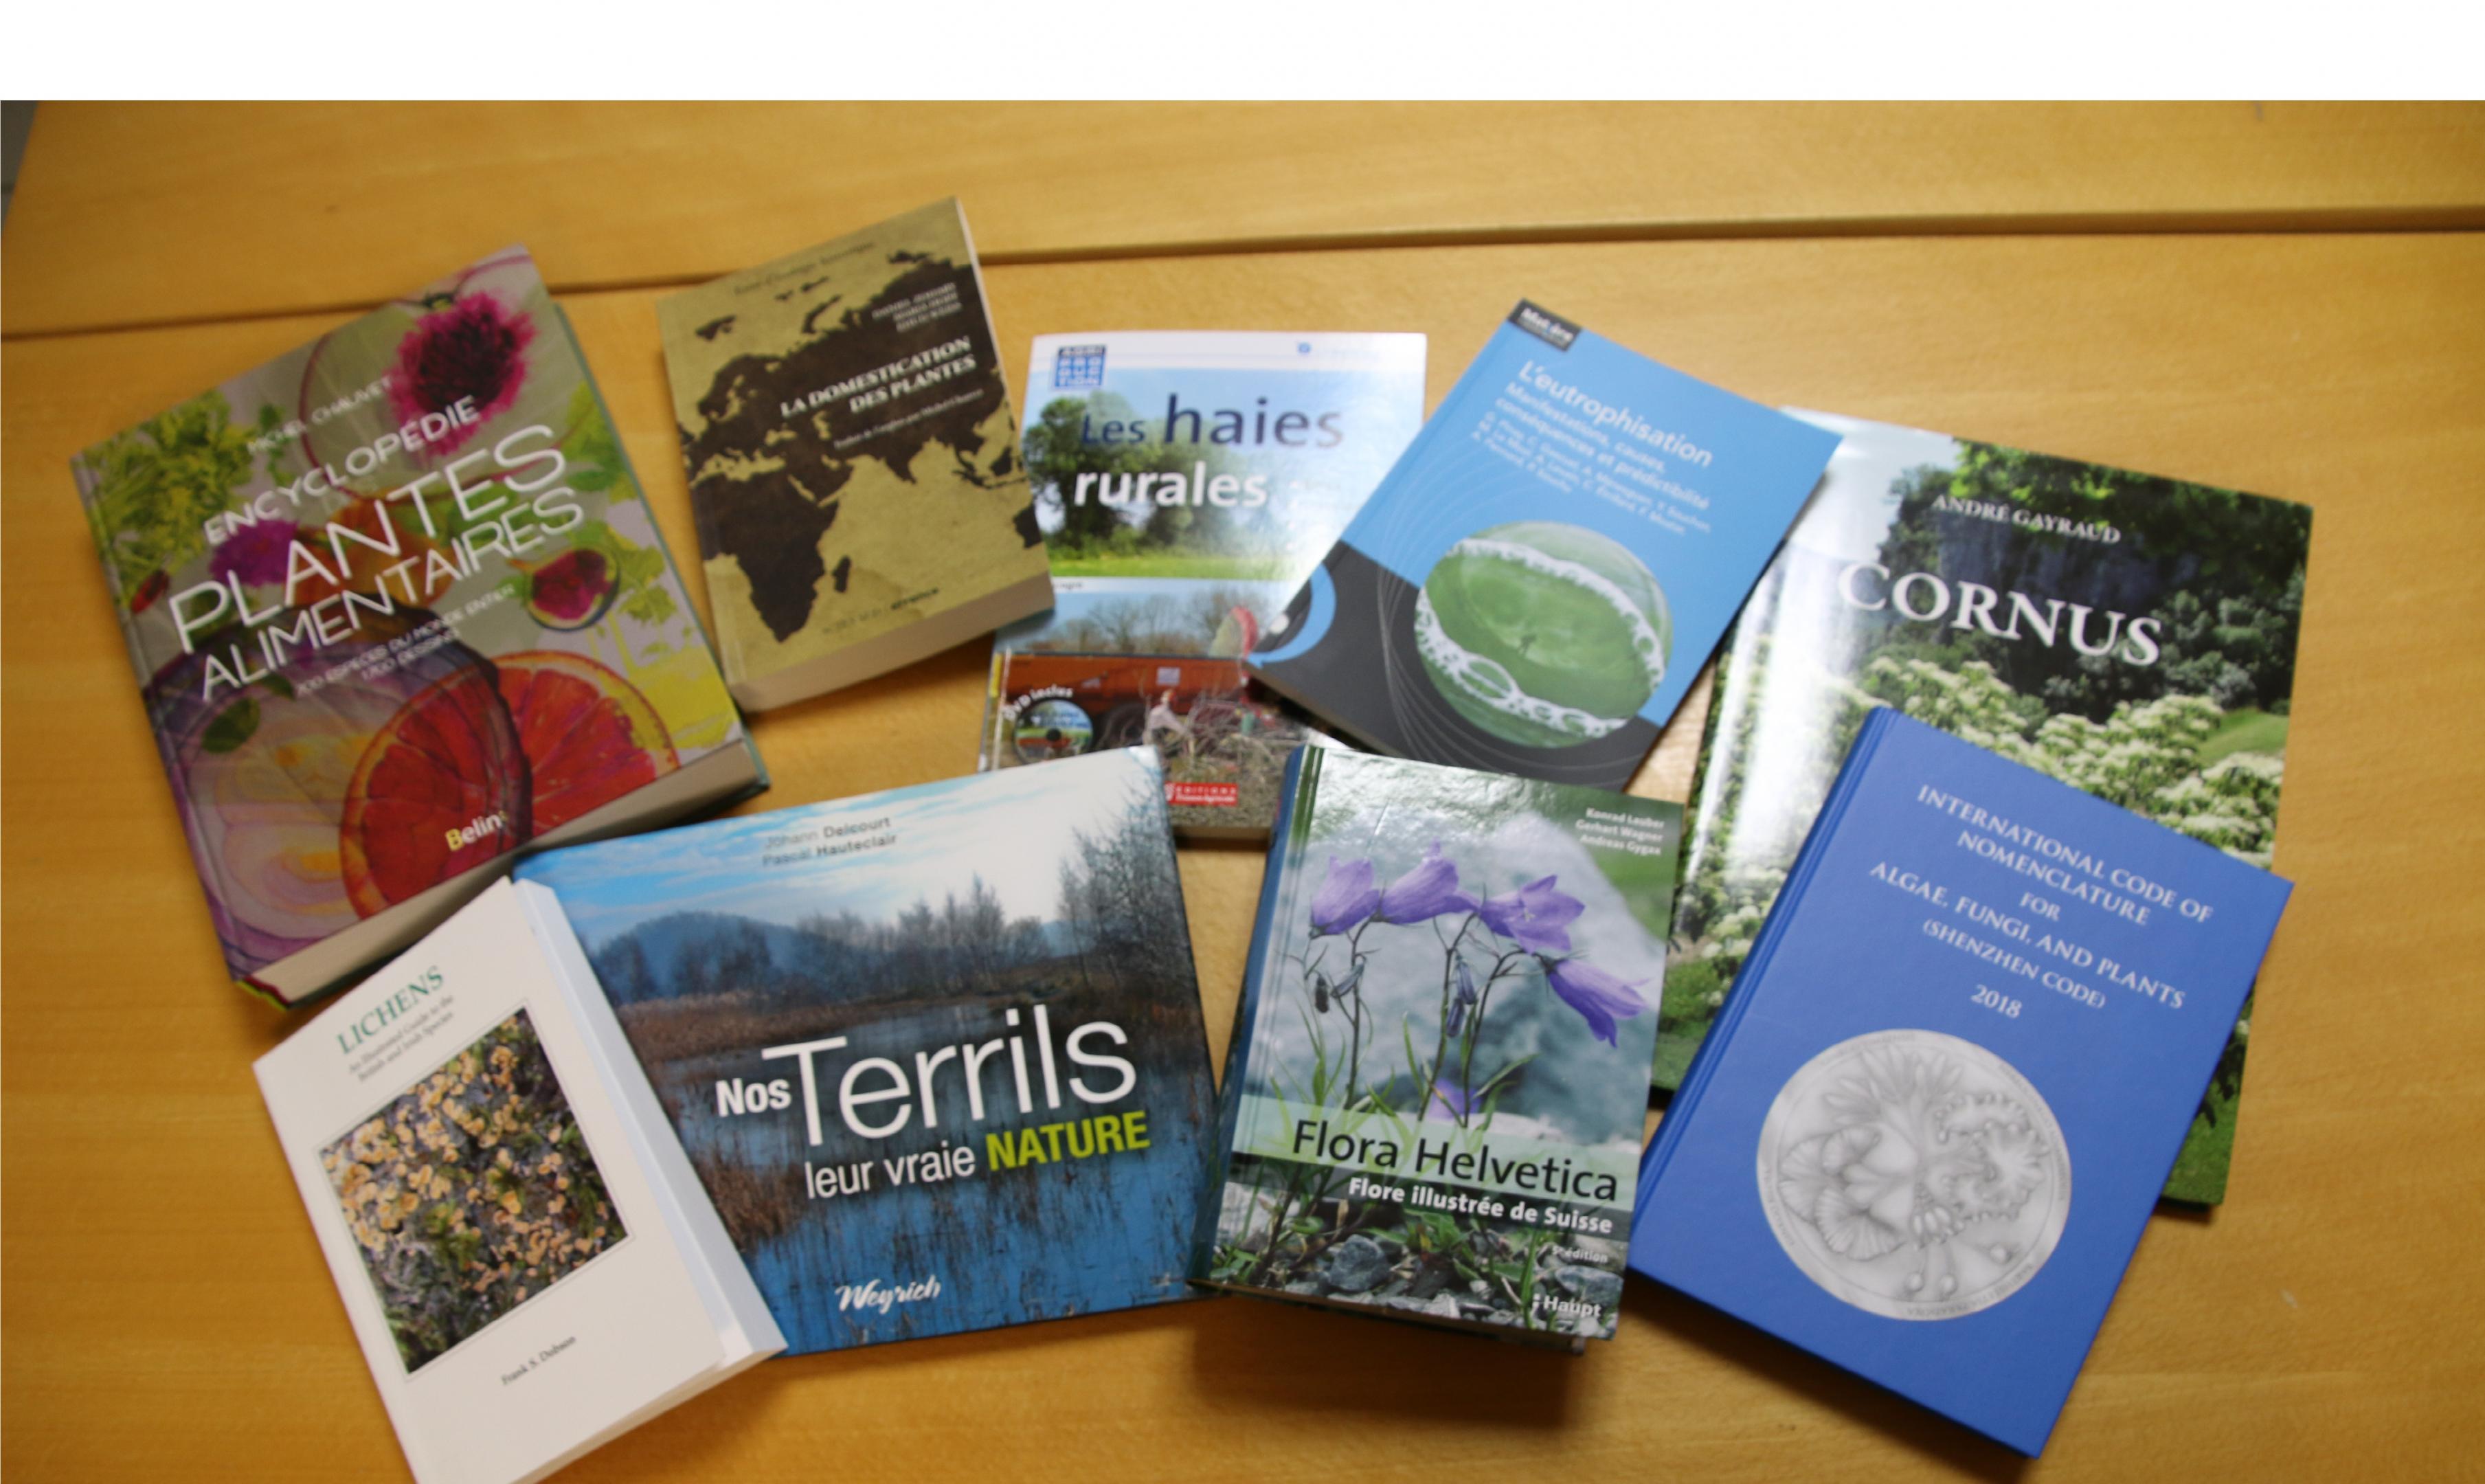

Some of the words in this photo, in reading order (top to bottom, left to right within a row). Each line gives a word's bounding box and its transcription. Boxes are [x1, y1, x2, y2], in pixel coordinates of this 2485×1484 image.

[780, 398, 807, 418] LA
[808, 335, 971, 407] DOMESTICATION
[849, 387, 889, 413] DES
[890, 354, 976, 398] PLANTES
[1518, 360, 1713, 468] L'eutrophisation
[1080, 414, 1145, 445] Les
[1165, 393, 1345, 449] haies
[1496, 398, 1596, 456] conséquences
[1597, 452, 1615, 466] et
[1074, 461, 1268, 507] rurales
[1931, 493, 2011, 523] ANDRÉ
[2012, 508, 2122, 545] GAYRAUD
[168, 425, 566, 655] PLANTES
[201, 486, 585, 702] ALIMENTAIRES
[1837, 561, 2163, 667] CORNUS
[816, 833, 897, 857] Hauteclair
[823, 817, 891, 838] Delcourt
[1918, 784, 2104, 879] INTERNATIONAL
[2111, 868, 2177, 908] CODE
[2180, 898, 2214, 923] OF
[1957, 830, 2150, 926] NOMENCLATURE
[2019, 892, 2061, 922] FOR
[1869, 862, 1948, 907] ALGAE,
[1955, 896, 2032, 945] FUNGI,
[2035, 934, 2093, 968] AND
[2096, 957, 2186, 1009] PLANTS
[1923, 918, 2040, 980] (SHENZHEN
[2041, 971, 2106, 1009] CODE)
[337, 965, 444, 1055] LICHENS
[1971, 984, 2023, 1019] 2018
[715, 1077, 791, 1118] Nos
[761, 1004, 1138, 1147] Terrils
[805, 1159, 872, 1200] leur
[884, 1140, 978, 1187] vraie
[986, 1110, 1151, 1171] NATURE
[1293, 1119, 1398, 1168] Flora
[1415, 1138, 1617, 1201] Helvetica
[1349, 1177, 1405, 1203] Flore
[1410, 1185, 1504, 1217] illustrée
[1511, 1201, 1538, 1223] de
[1543, 1207, 1612, 1234] Suisse
[833, 1274, 942, 1316] Weyrich
[1543, 1295, 1602, 1318] Haupt
